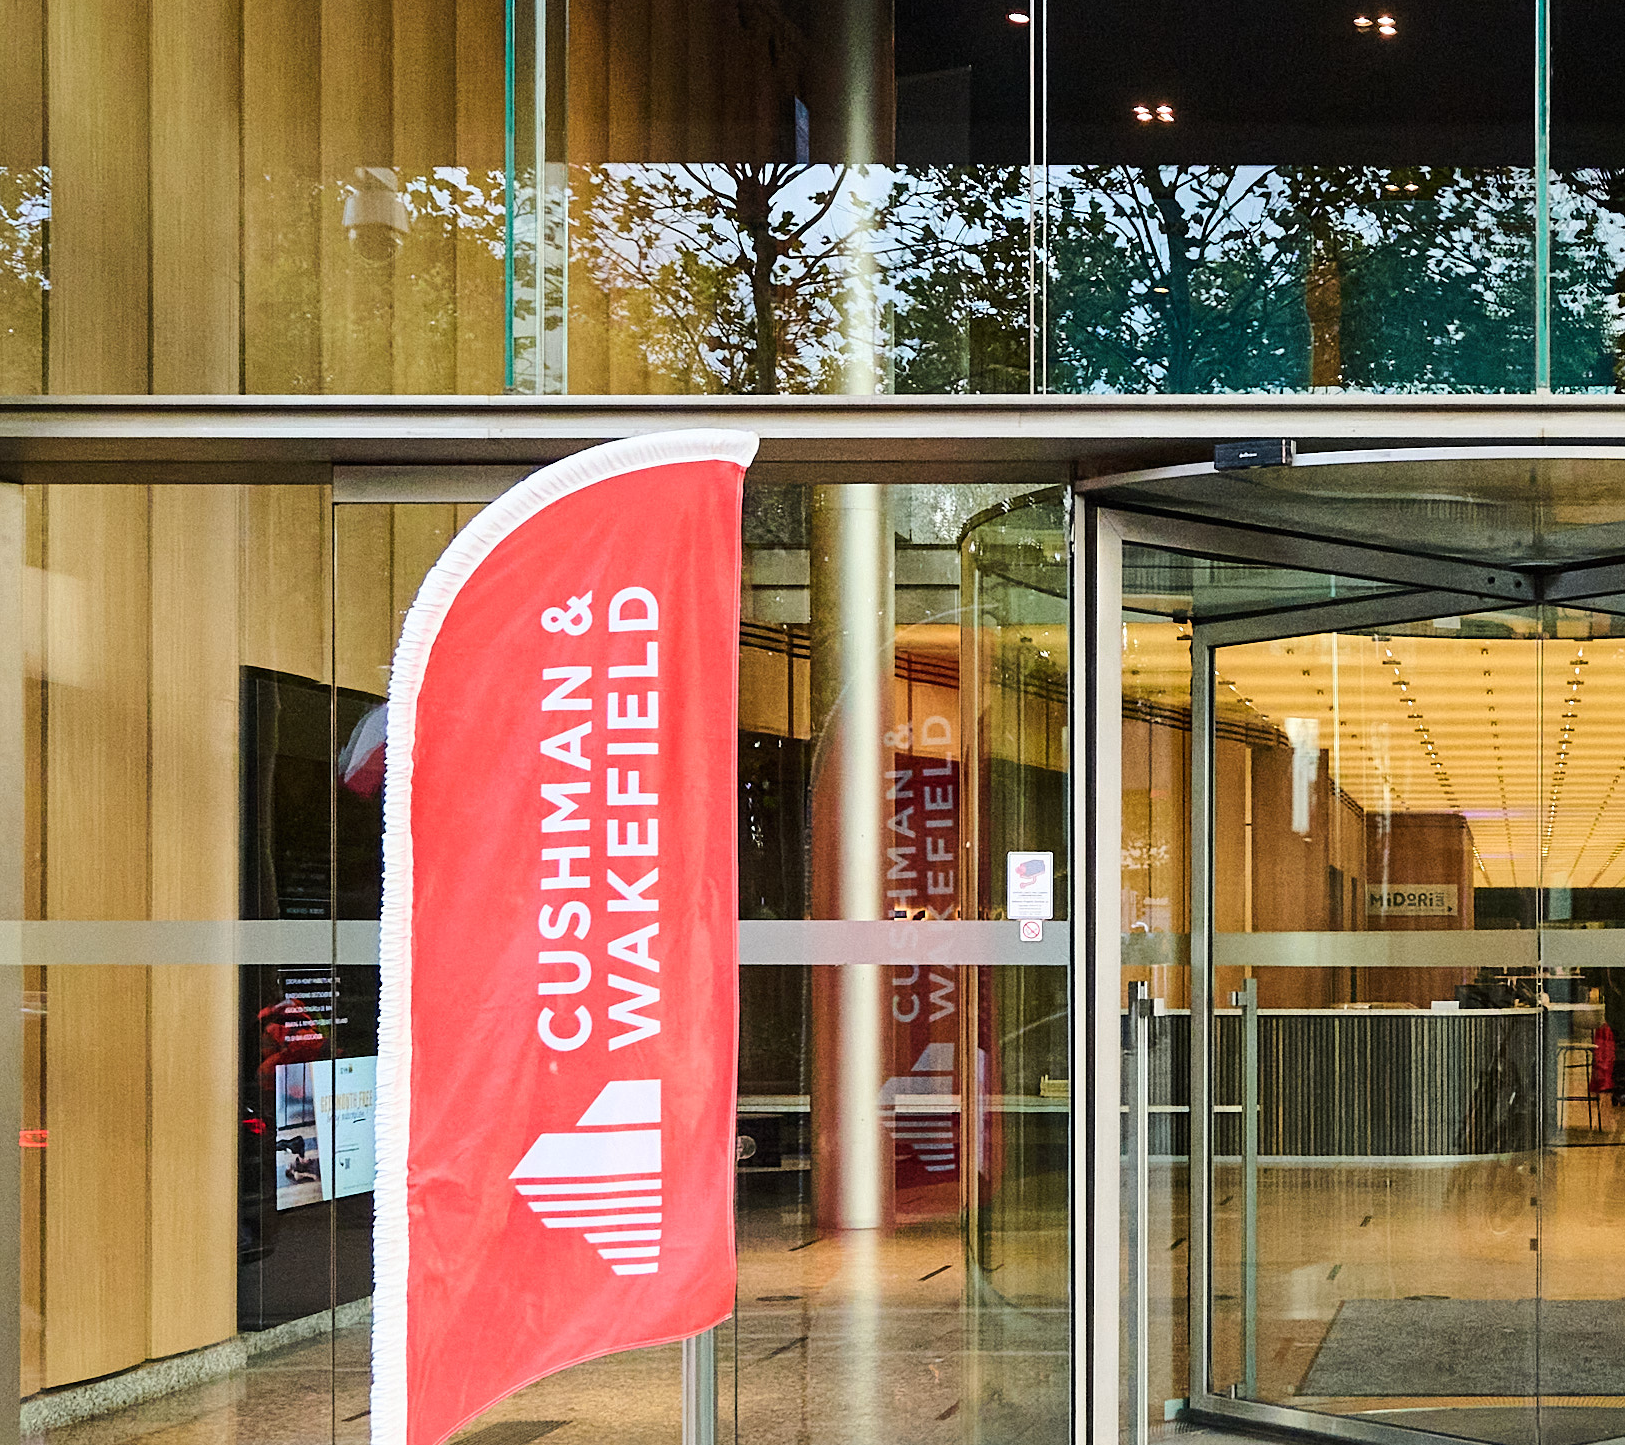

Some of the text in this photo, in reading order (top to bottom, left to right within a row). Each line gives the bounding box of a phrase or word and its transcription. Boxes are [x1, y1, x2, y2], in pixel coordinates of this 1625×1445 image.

[537, 589, 594, 1054] CUSHMAN &
[606, 585, 661, 1053] WAKEFIELD
